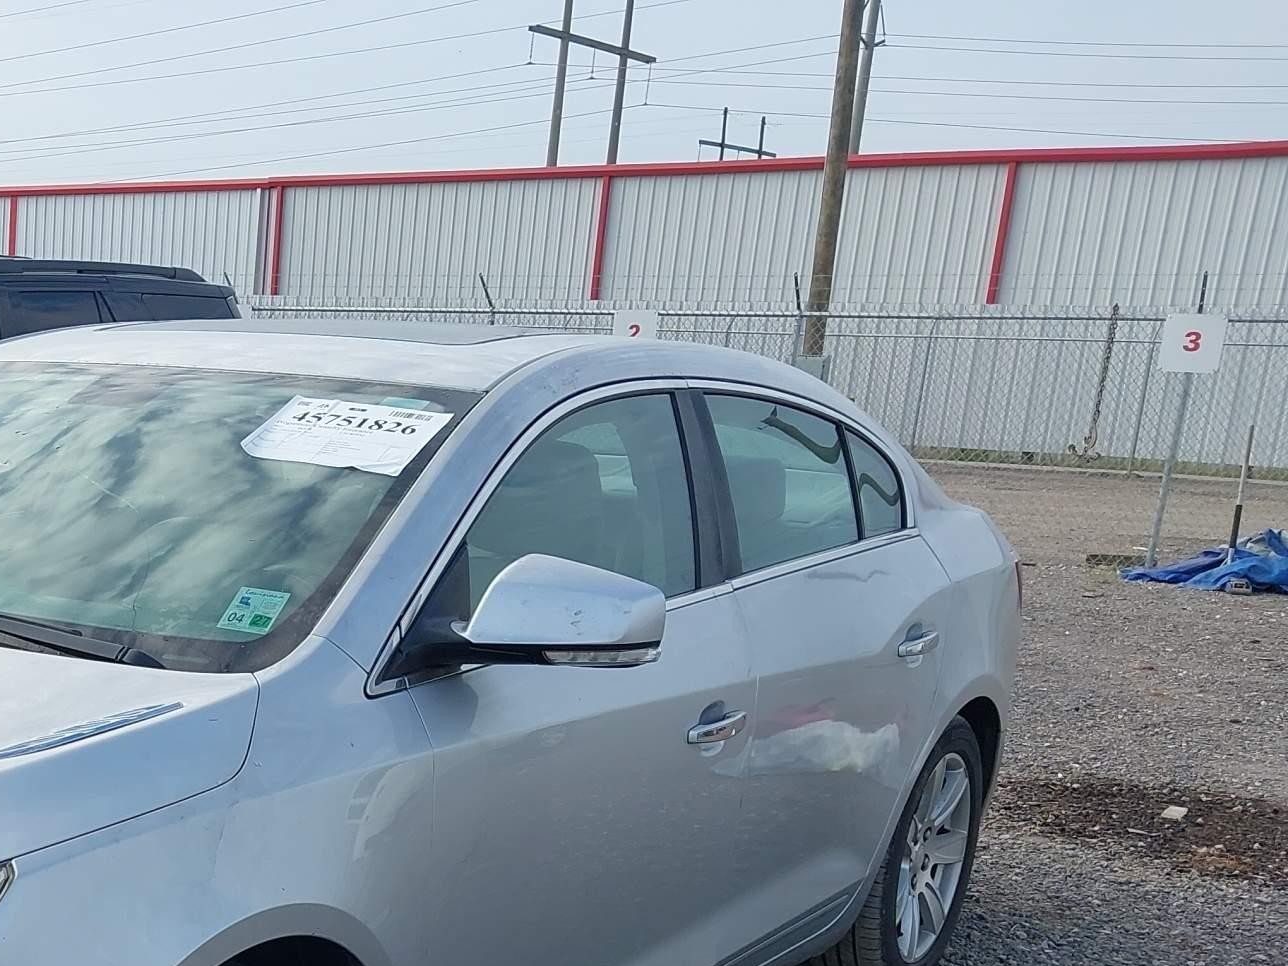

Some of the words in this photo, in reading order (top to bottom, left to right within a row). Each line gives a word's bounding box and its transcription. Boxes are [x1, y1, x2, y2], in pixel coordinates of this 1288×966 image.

[629, 324, 641, 337] 2
[1182, 331, 1202, 352] 3
[291, 410, 419, 437] 45751826
[227, 612, 245, 624] 04
[255, 615, 271, 627] 27
